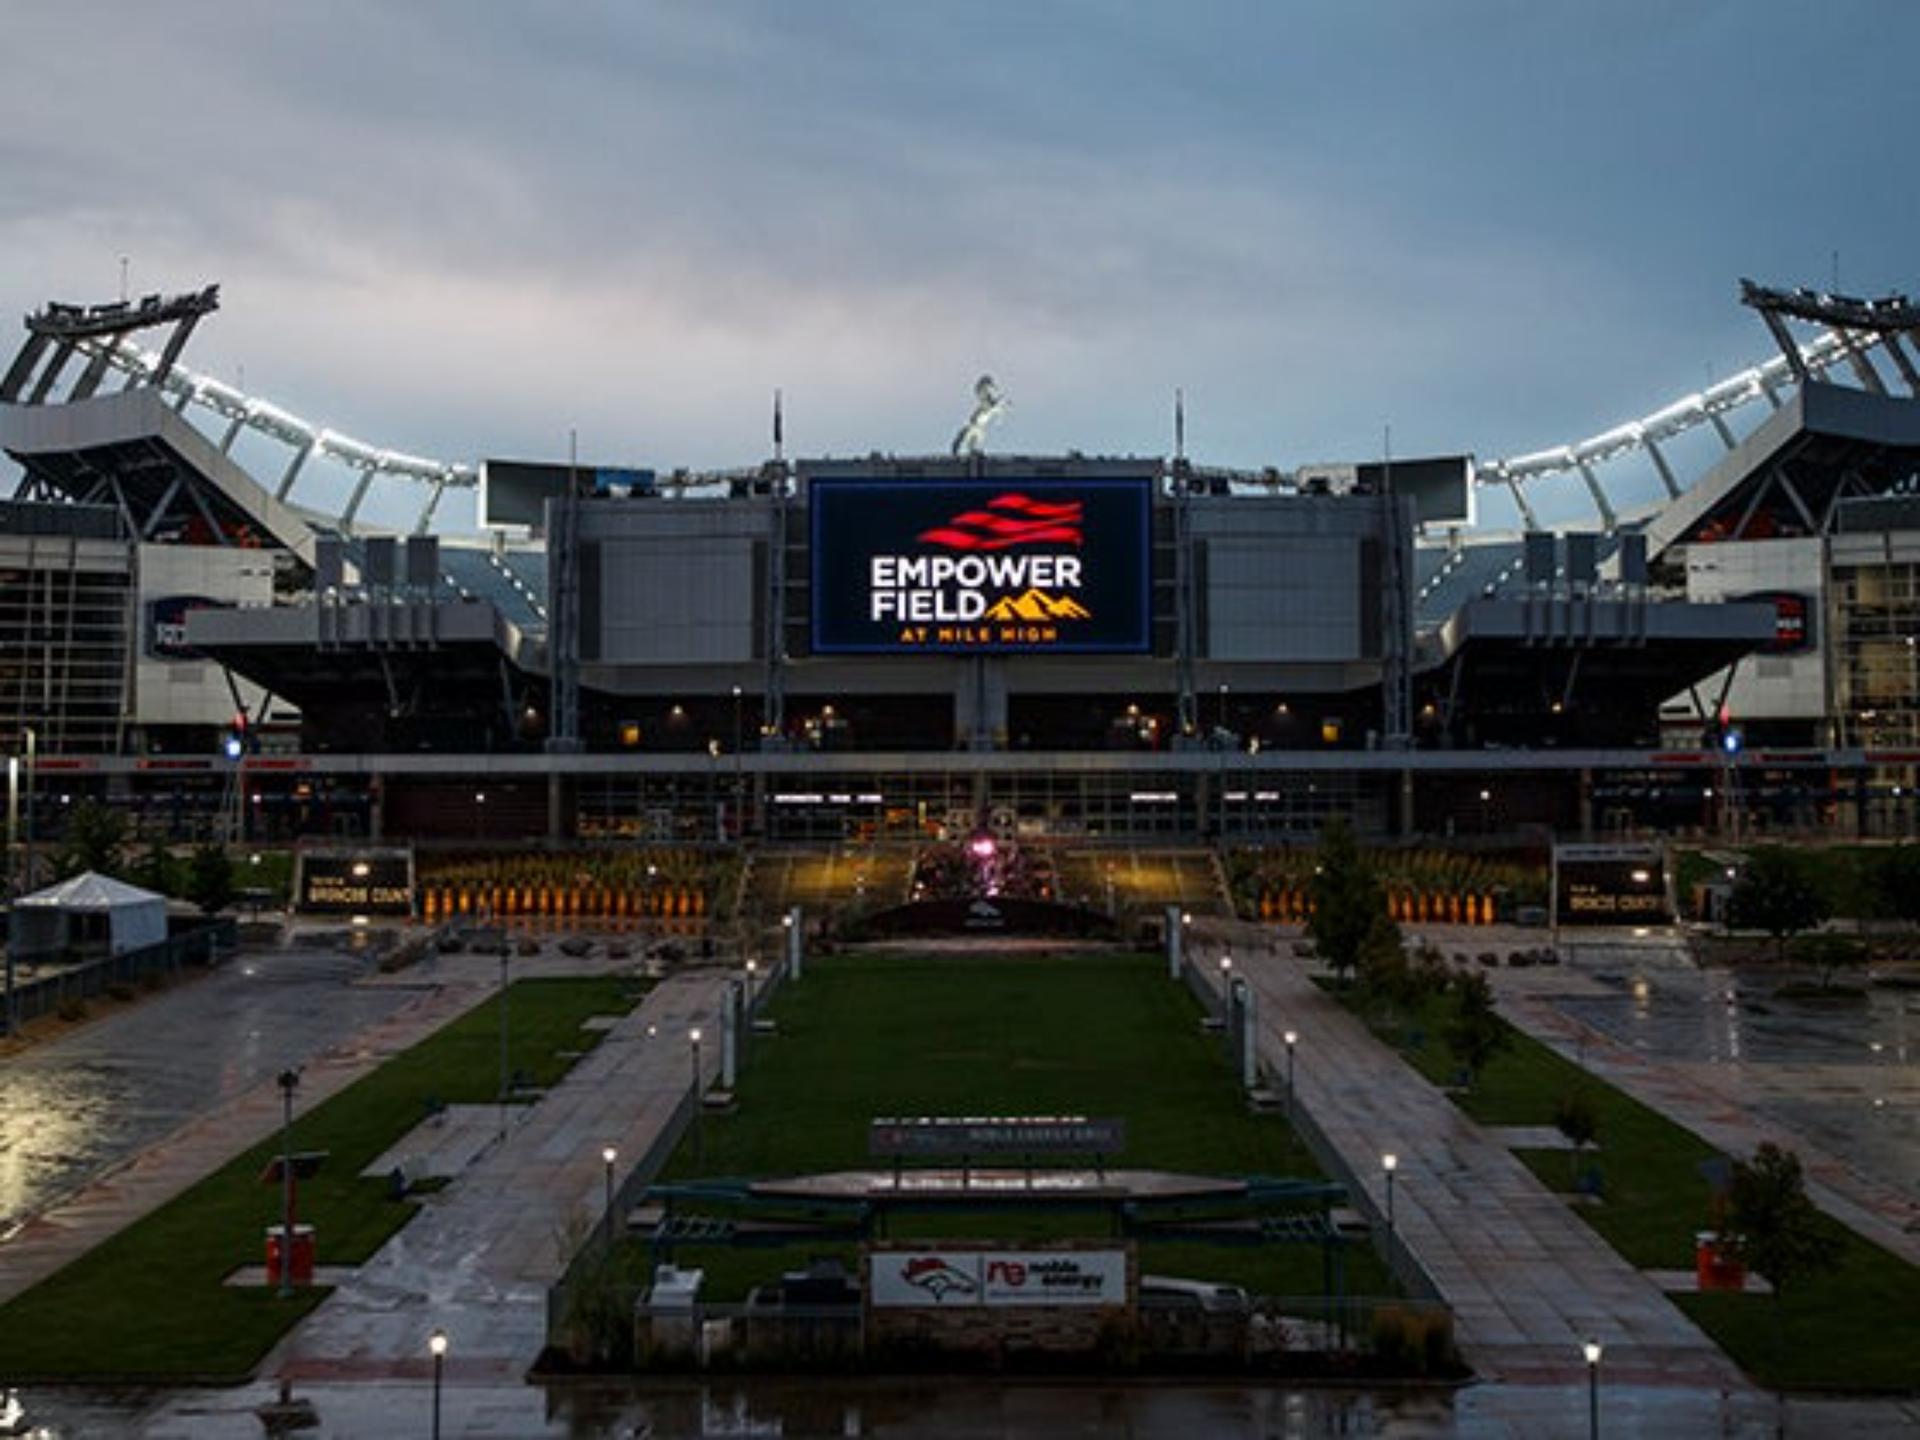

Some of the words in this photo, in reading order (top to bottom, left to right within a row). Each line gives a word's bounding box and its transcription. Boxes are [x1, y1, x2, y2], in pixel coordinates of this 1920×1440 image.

[872, 557, 1081, 587] EMPOWER
[872, 590, 986, 621] FIELD
[901, 628, 927, 642] AT
[938, 628, 991, 642] MILE
[1001, 628, 1057, 642] HIGH
